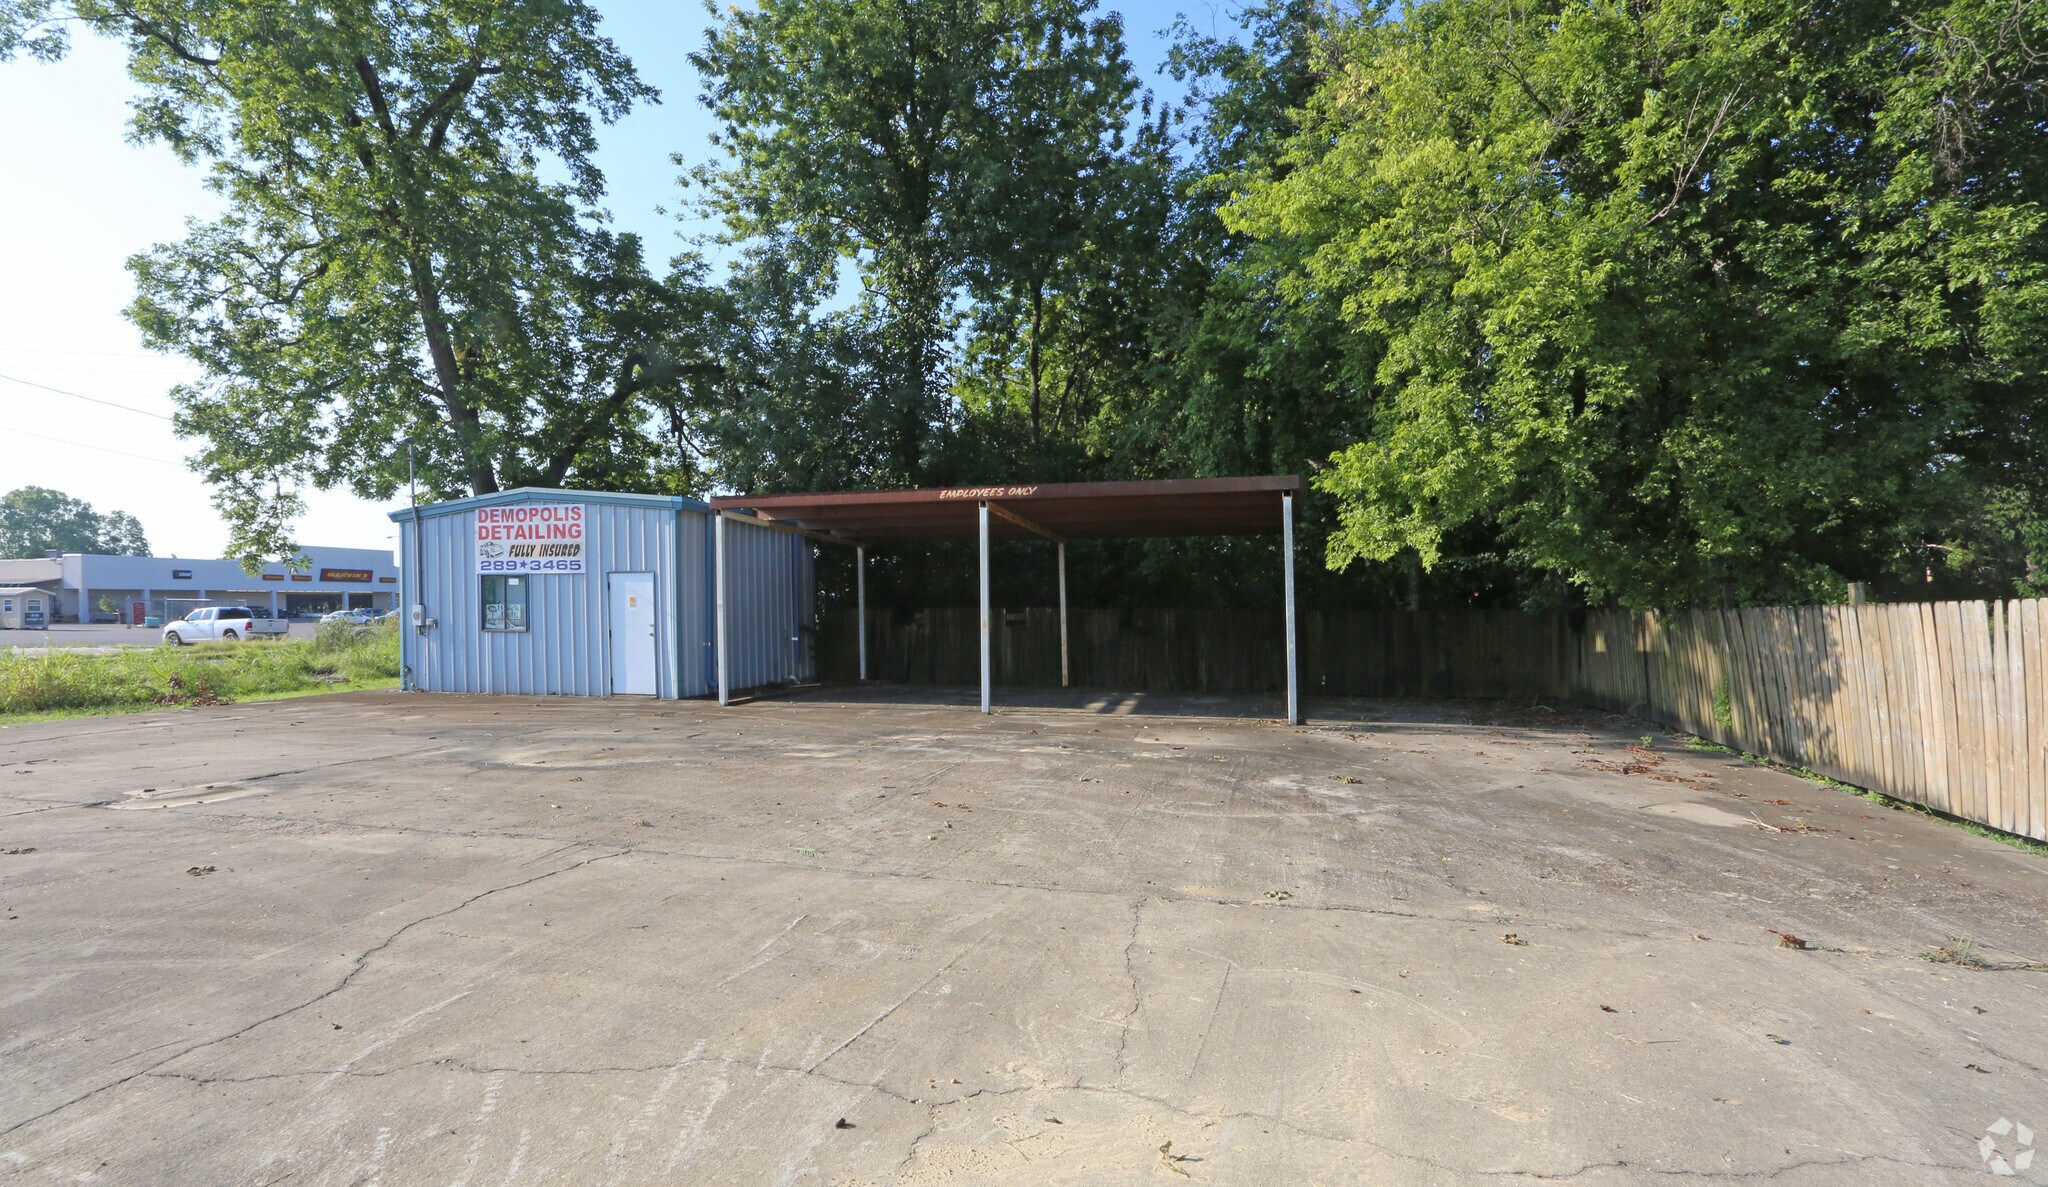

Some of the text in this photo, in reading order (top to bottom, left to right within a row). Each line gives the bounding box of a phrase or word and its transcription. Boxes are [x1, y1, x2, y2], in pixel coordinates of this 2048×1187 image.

[940, 486, 1037, 499] EMPLOYEES ONLY
[478, 506, 582, 523] DEMOPOLIS
[478, 523, 582, 540] DETAILING
[509, 543, 581, 557] FULLY INSURED
